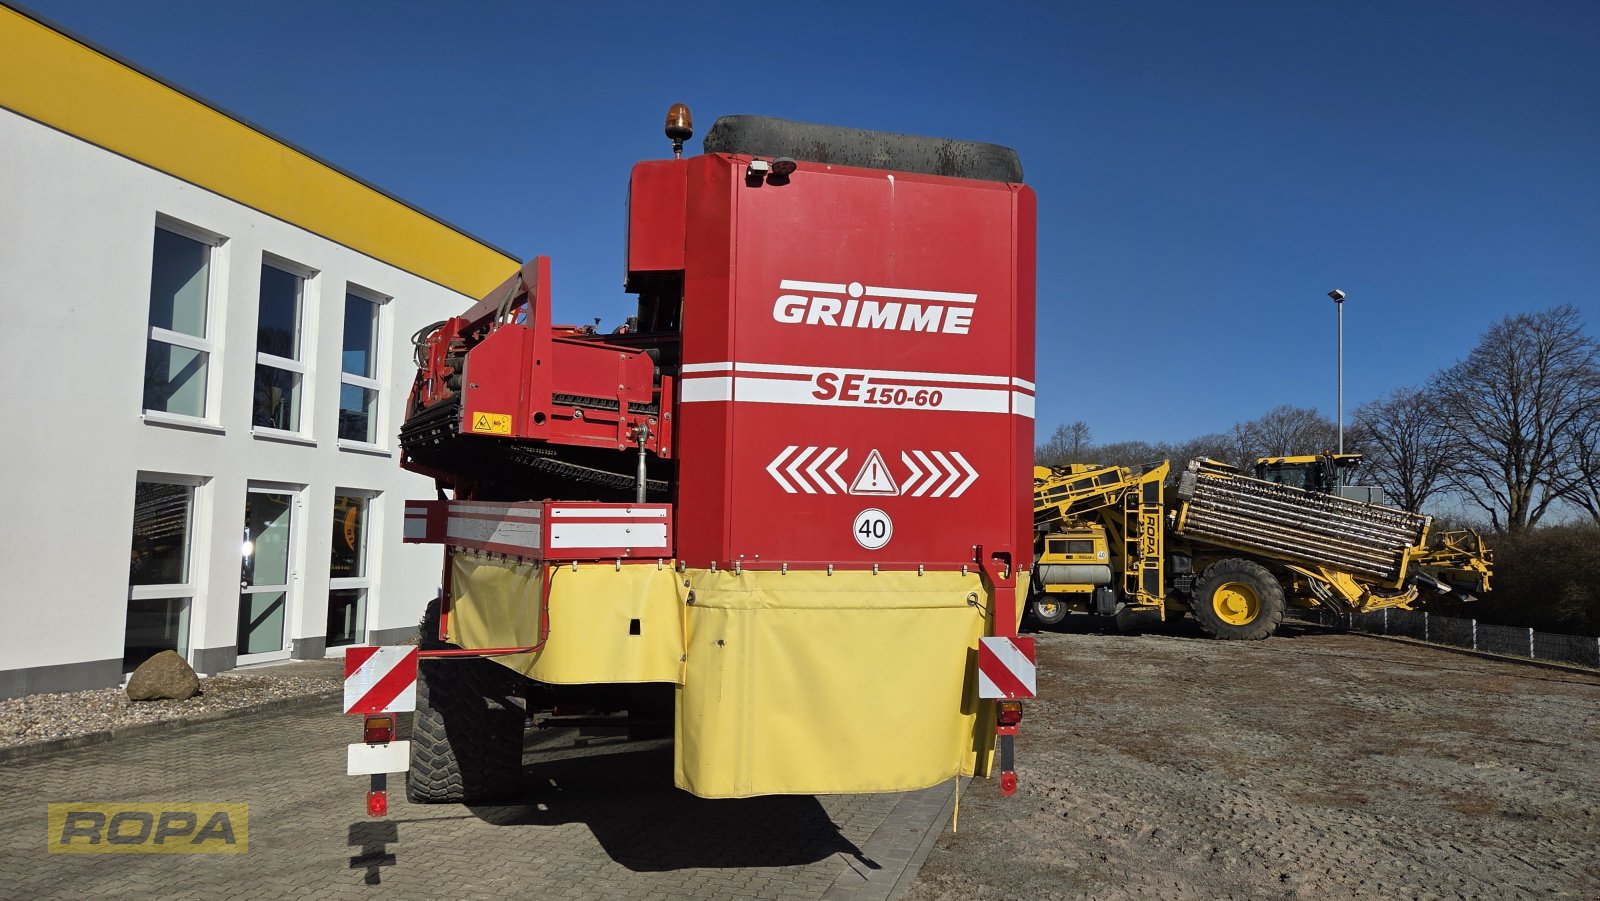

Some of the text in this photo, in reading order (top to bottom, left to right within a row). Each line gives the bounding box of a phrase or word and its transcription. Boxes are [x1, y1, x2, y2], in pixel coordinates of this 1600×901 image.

[772, 282, 975, 335] GRIMME
[811, 372, 943, 407] SE 150-60
[858, 518, 886, 538] 40
[1147, 516, 1155, 555] ROPA
